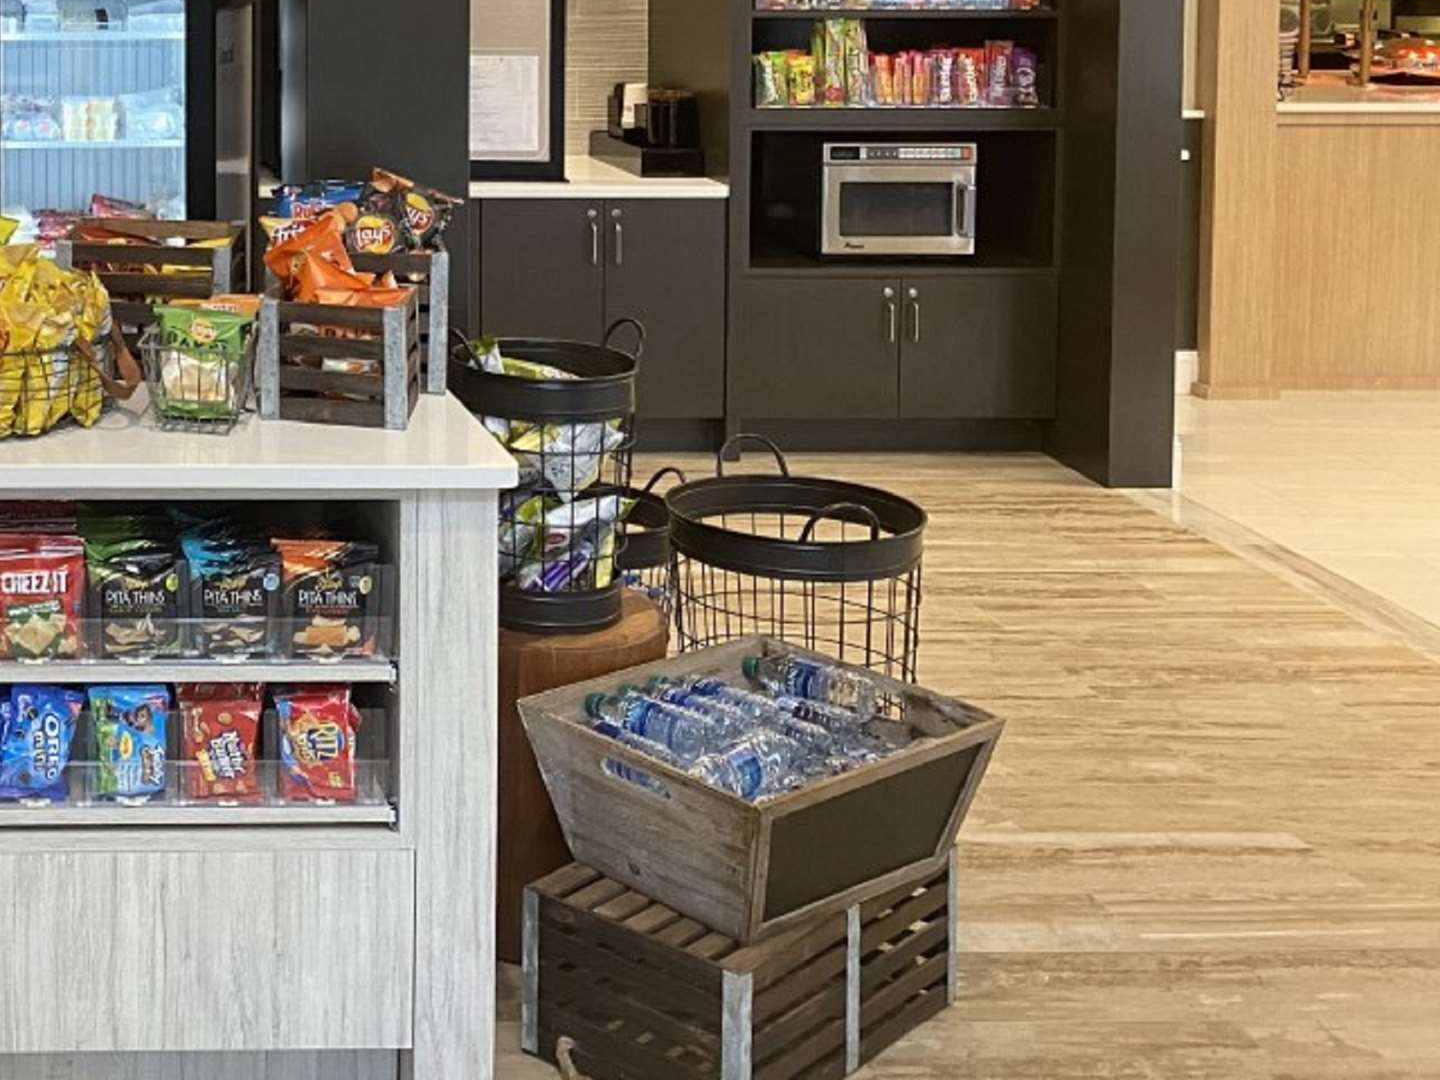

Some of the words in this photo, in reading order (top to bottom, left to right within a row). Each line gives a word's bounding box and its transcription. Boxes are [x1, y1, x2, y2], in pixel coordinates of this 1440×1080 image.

[105, 588, 132, 605] PITA
[133, 588, 166, 604] THINS
[203, 587, 230, 603] PITA
[232, 587, 263, 604] THINS
[298, 588, 325, 605] PITA
[43, 713, 60, 781] OREO
[317, 721, 340, 761] RITZ
